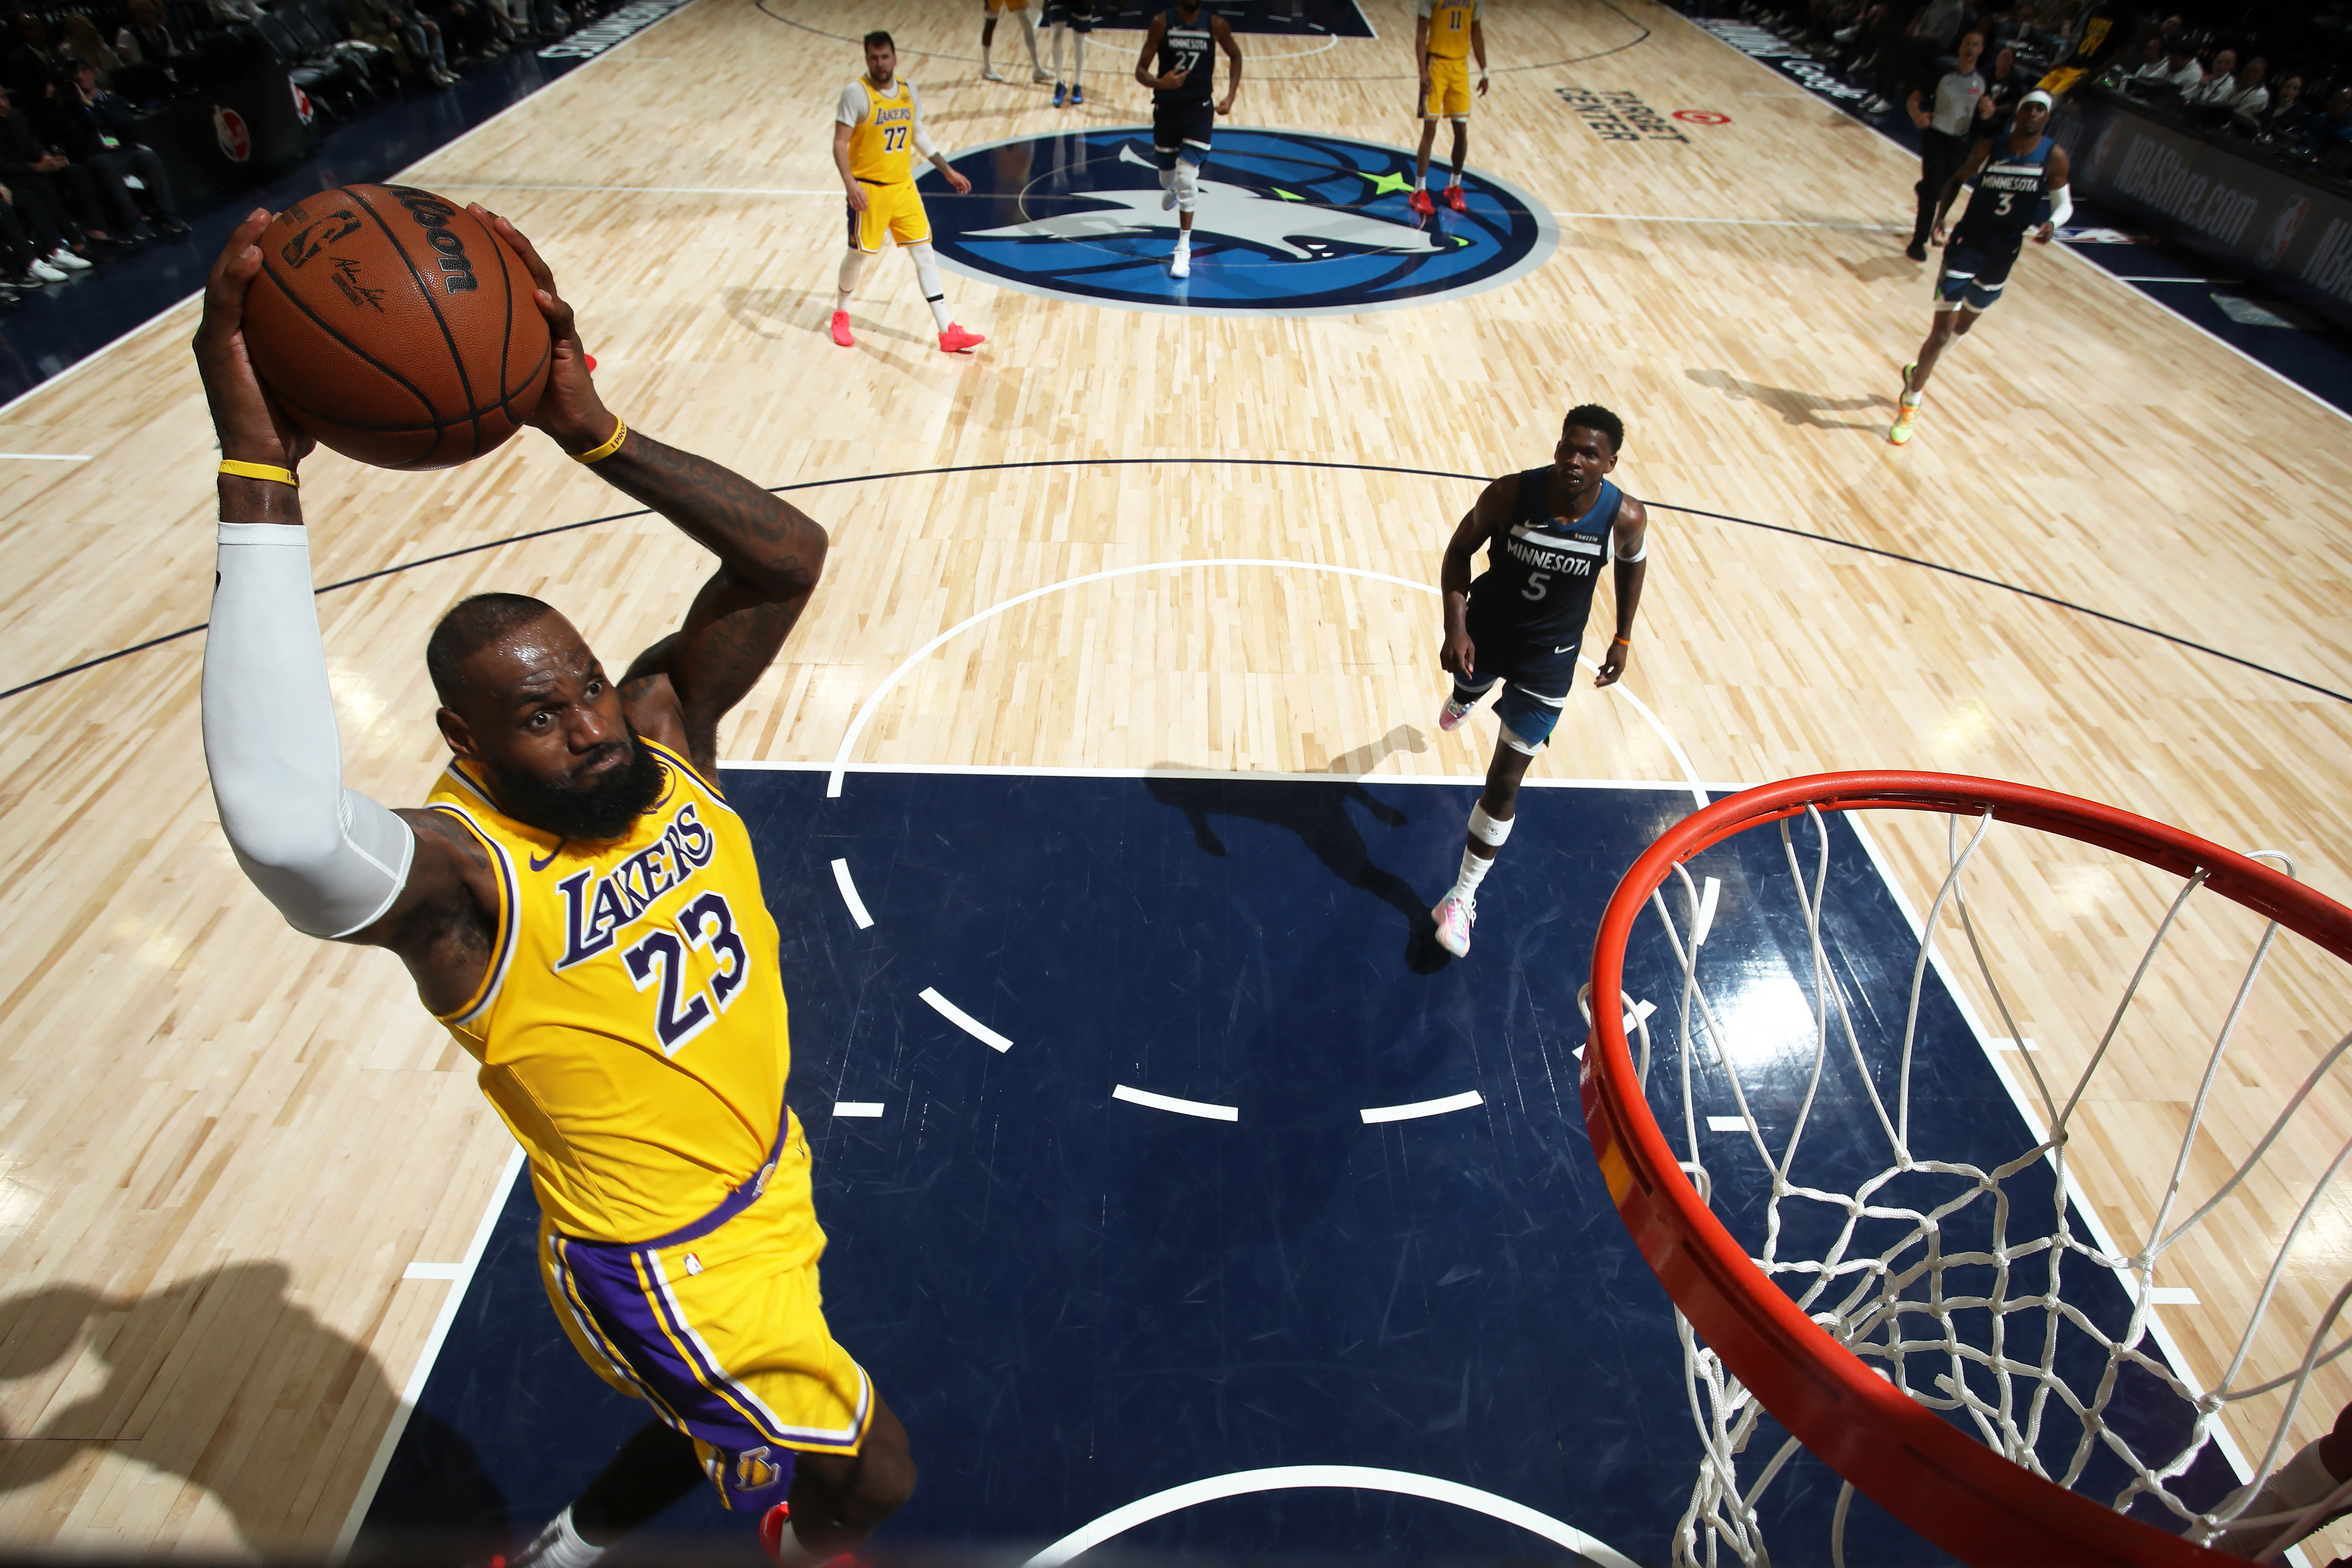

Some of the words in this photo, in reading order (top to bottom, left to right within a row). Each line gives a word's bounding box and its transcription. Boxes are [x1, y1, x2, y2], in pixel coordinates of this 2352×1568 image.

[1449, 11, 1461, 31] 11
[1174, 51, 1200, 71] 27
[873, 107, 911, 126] LAKERS
[1555, 87, 1640, 141] CENTER
[1600, 89, 1691, 144] TARGET
[883, 125, 907, 153] 77
[1981, 175, 2039, 192] MINNESOTA
[2112, 134, 2258, 246] NBAStore.com
[1994, 193, 2016, 216] 3
[2300, 218, 2352, 303] NBA
[1578, 533, 1599, 542] sezzle
[1507, 538, 1591, 576] MINNESOTA
[1521, 571, 1551, 601] 5
[554, 802, 715, 972] LAKERS
[620, 890, 751, 1057] 23
